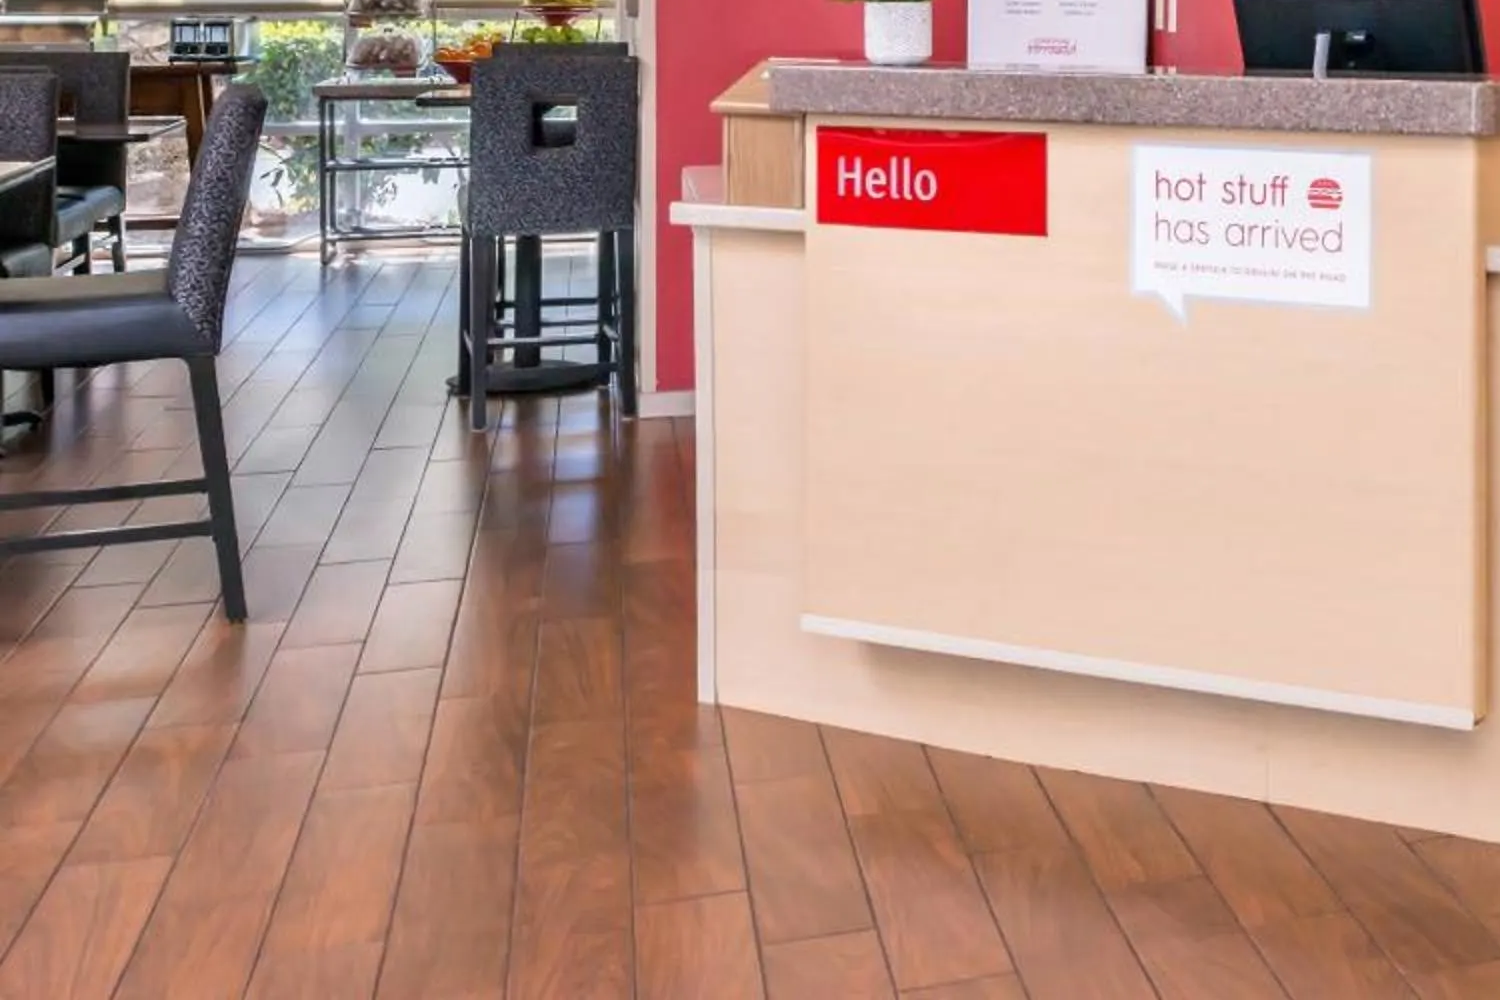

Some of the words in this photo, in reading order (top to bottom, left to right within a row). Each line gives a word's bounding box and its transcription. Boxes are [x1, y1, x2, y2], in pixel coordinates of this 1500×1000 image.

[837, 155, 938, 202] Hello
[1155, 170, 1207, 202] hot
[1221, 174, 1289, 207] stuff
[1155, 211, 1210, 246] has
[1225, 219, 1343, 254] arrived
